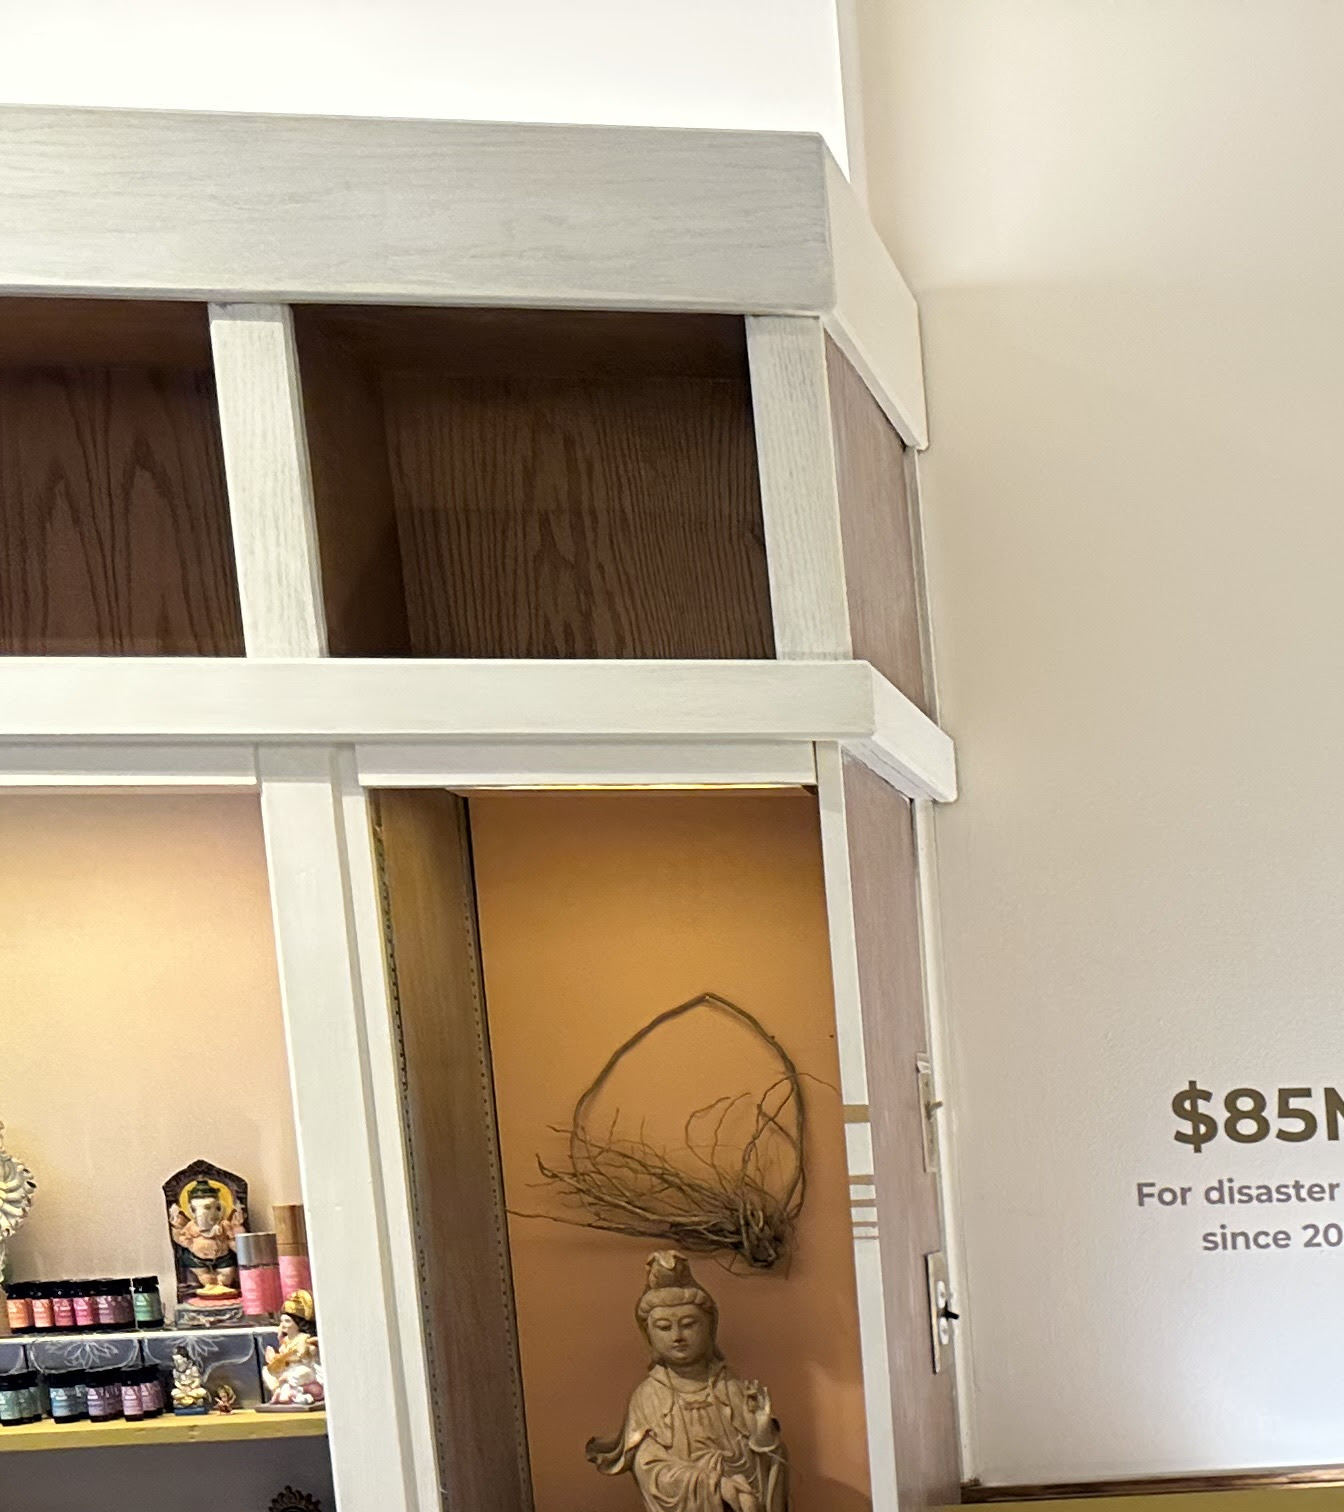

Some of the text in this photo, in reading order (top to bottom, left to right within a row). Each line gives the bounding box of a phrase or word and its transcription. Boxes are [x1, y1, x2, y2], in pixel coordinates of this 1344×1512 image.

[1136, 1182, 1193, 1207] For
[1204, 1175, 1341, 1205] disaster
[1203, 1224, 1292, 1252] since
